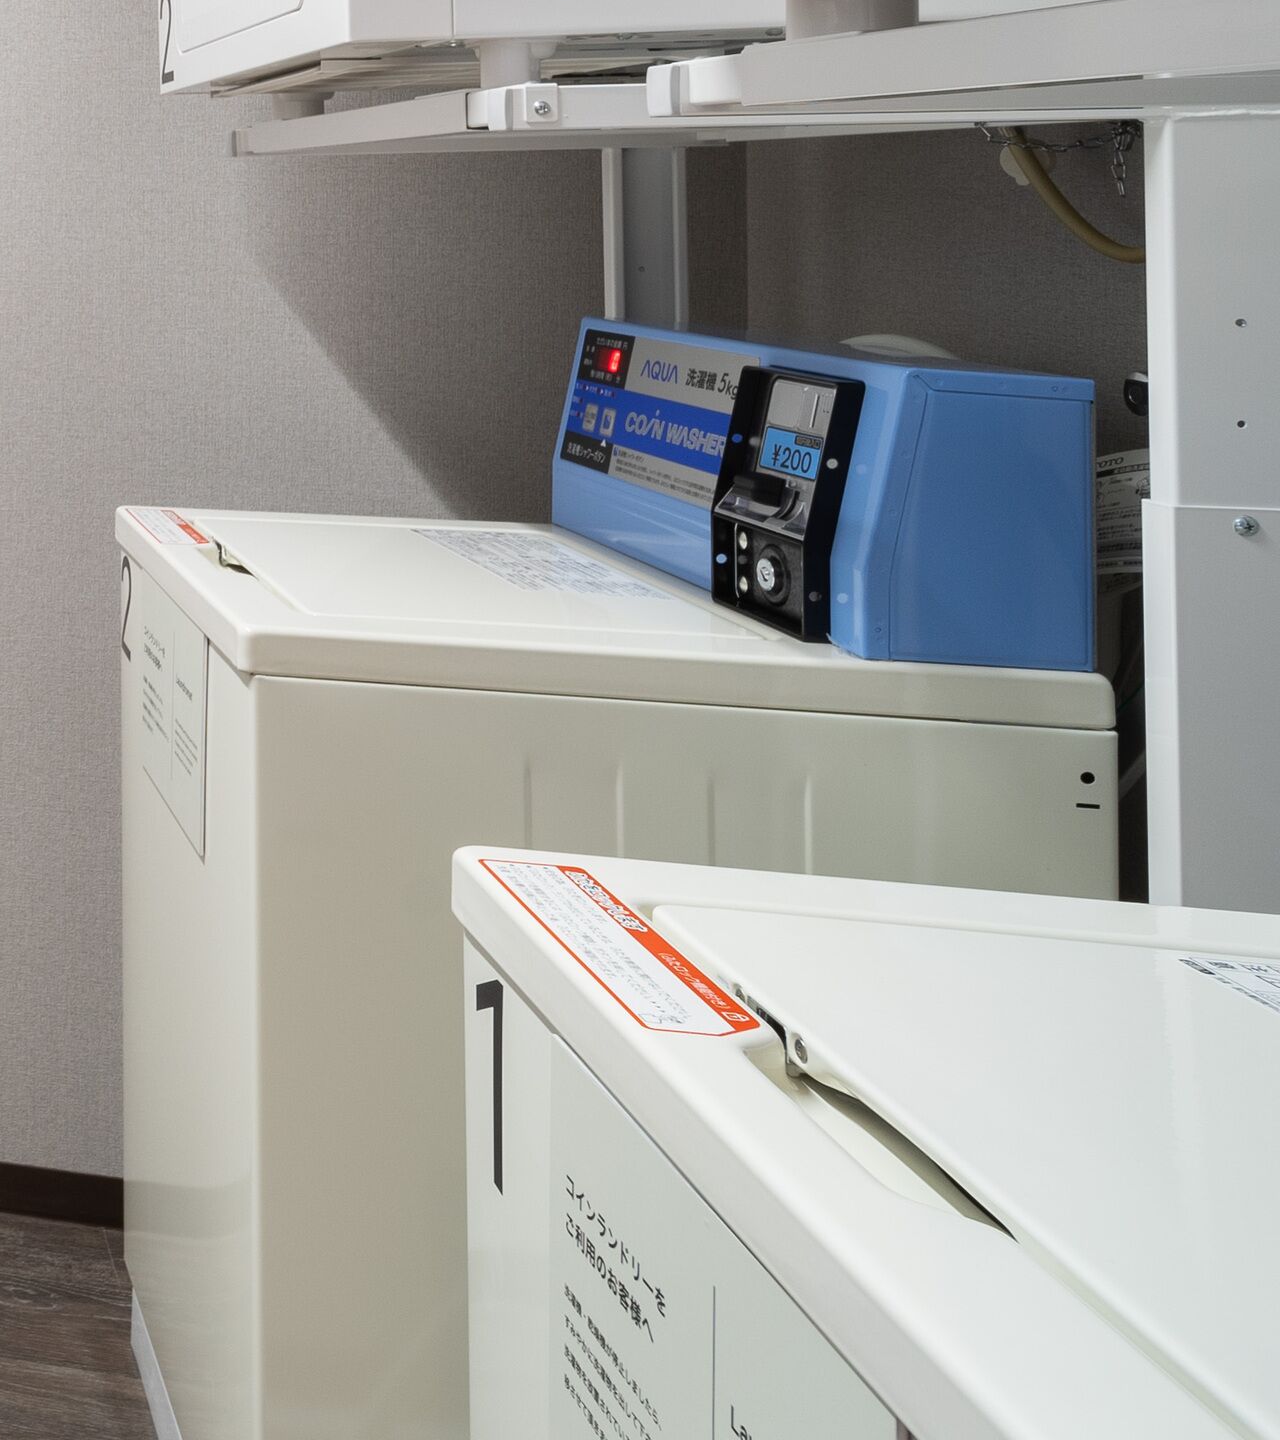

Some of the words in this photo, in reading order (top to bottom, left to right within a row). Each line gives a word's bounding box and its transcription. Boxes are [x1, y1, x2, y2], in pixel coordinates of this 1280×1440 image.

[624, 409, 664, 441] COIN
[640, 359, 678, 384] AQUA
[685, 368, 717, 392] 洗濯機
[718, 373, 740, 400] 5kg
[771, 444, 813, 473] ¥200
[121, 556, 132, 662] 2
[476, 979, 503, 1196] 1
[565, 1174, 666, 1318] コインランドリーを
[565, 1212, 654, 1345] ご利用のお客様へ
